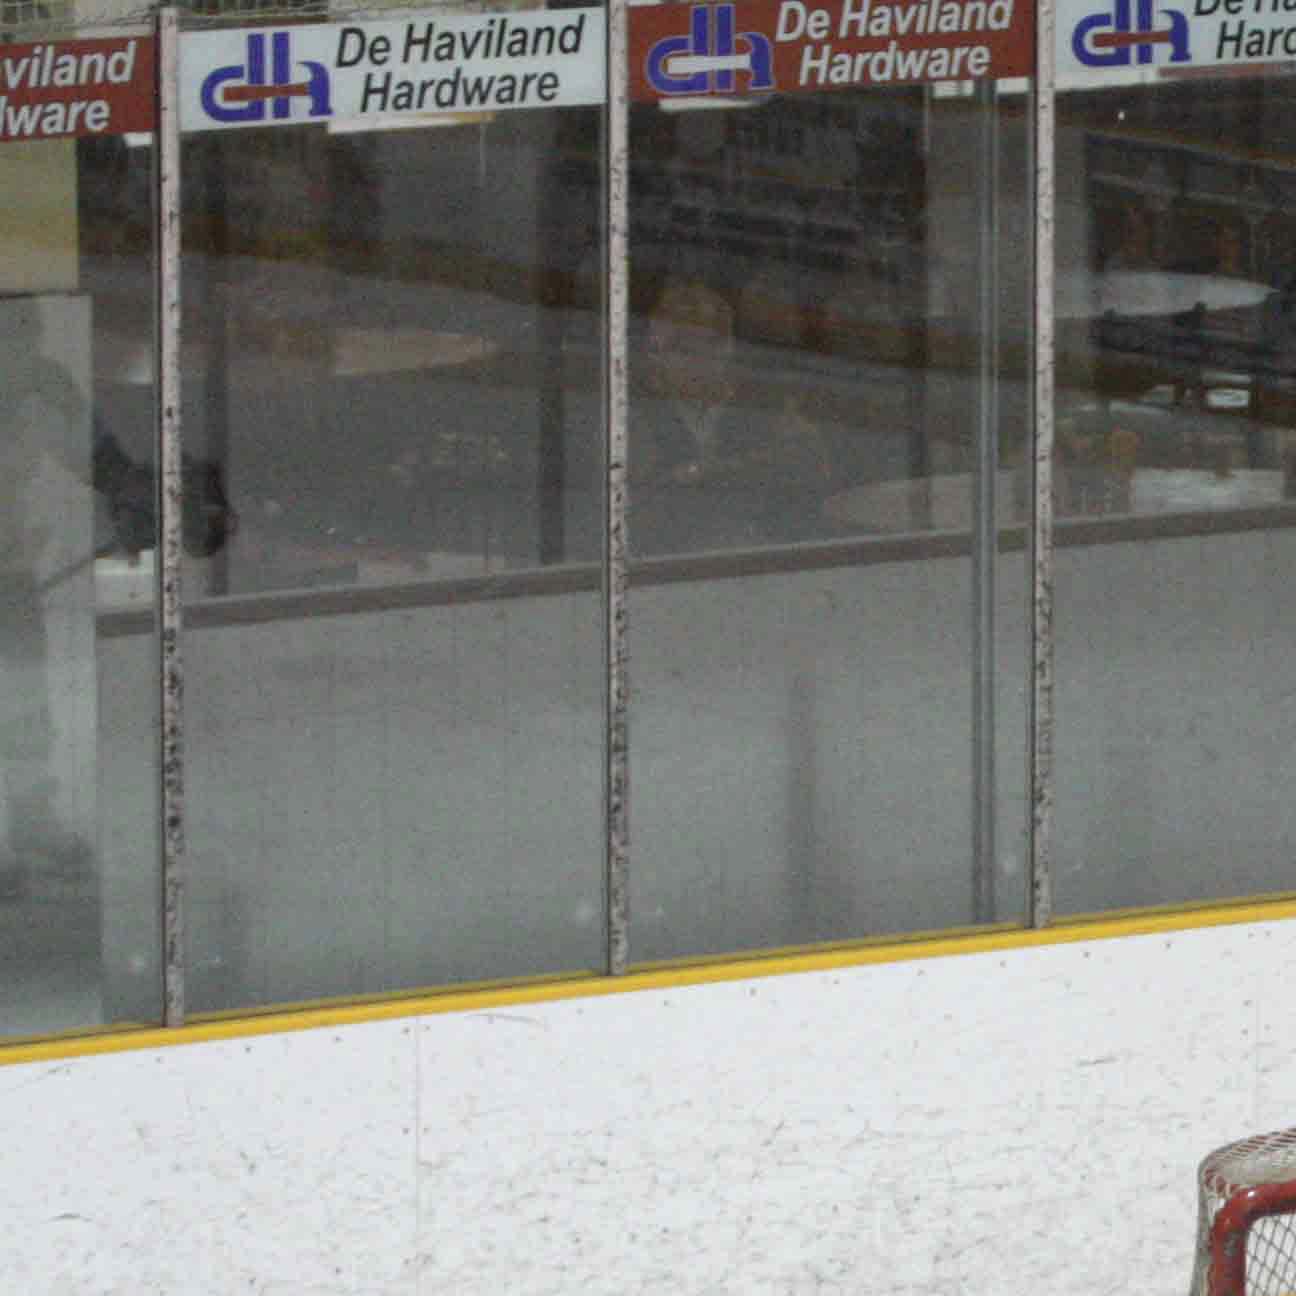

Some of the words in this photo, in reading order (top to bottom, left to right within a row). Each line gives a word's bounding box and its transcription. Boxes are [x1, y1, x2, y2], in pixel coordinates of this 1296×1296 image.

[335, 27, 392, 67] De
[402, 13, 586, 63] Haviland
[776, 1, 831, 42] De
[838, 0, 1014, 38] Haviland
[4, 40, 137, 89] viland
[800, 41, 991, 86] Hardware
[360, 66, 560, 112] Hardware
